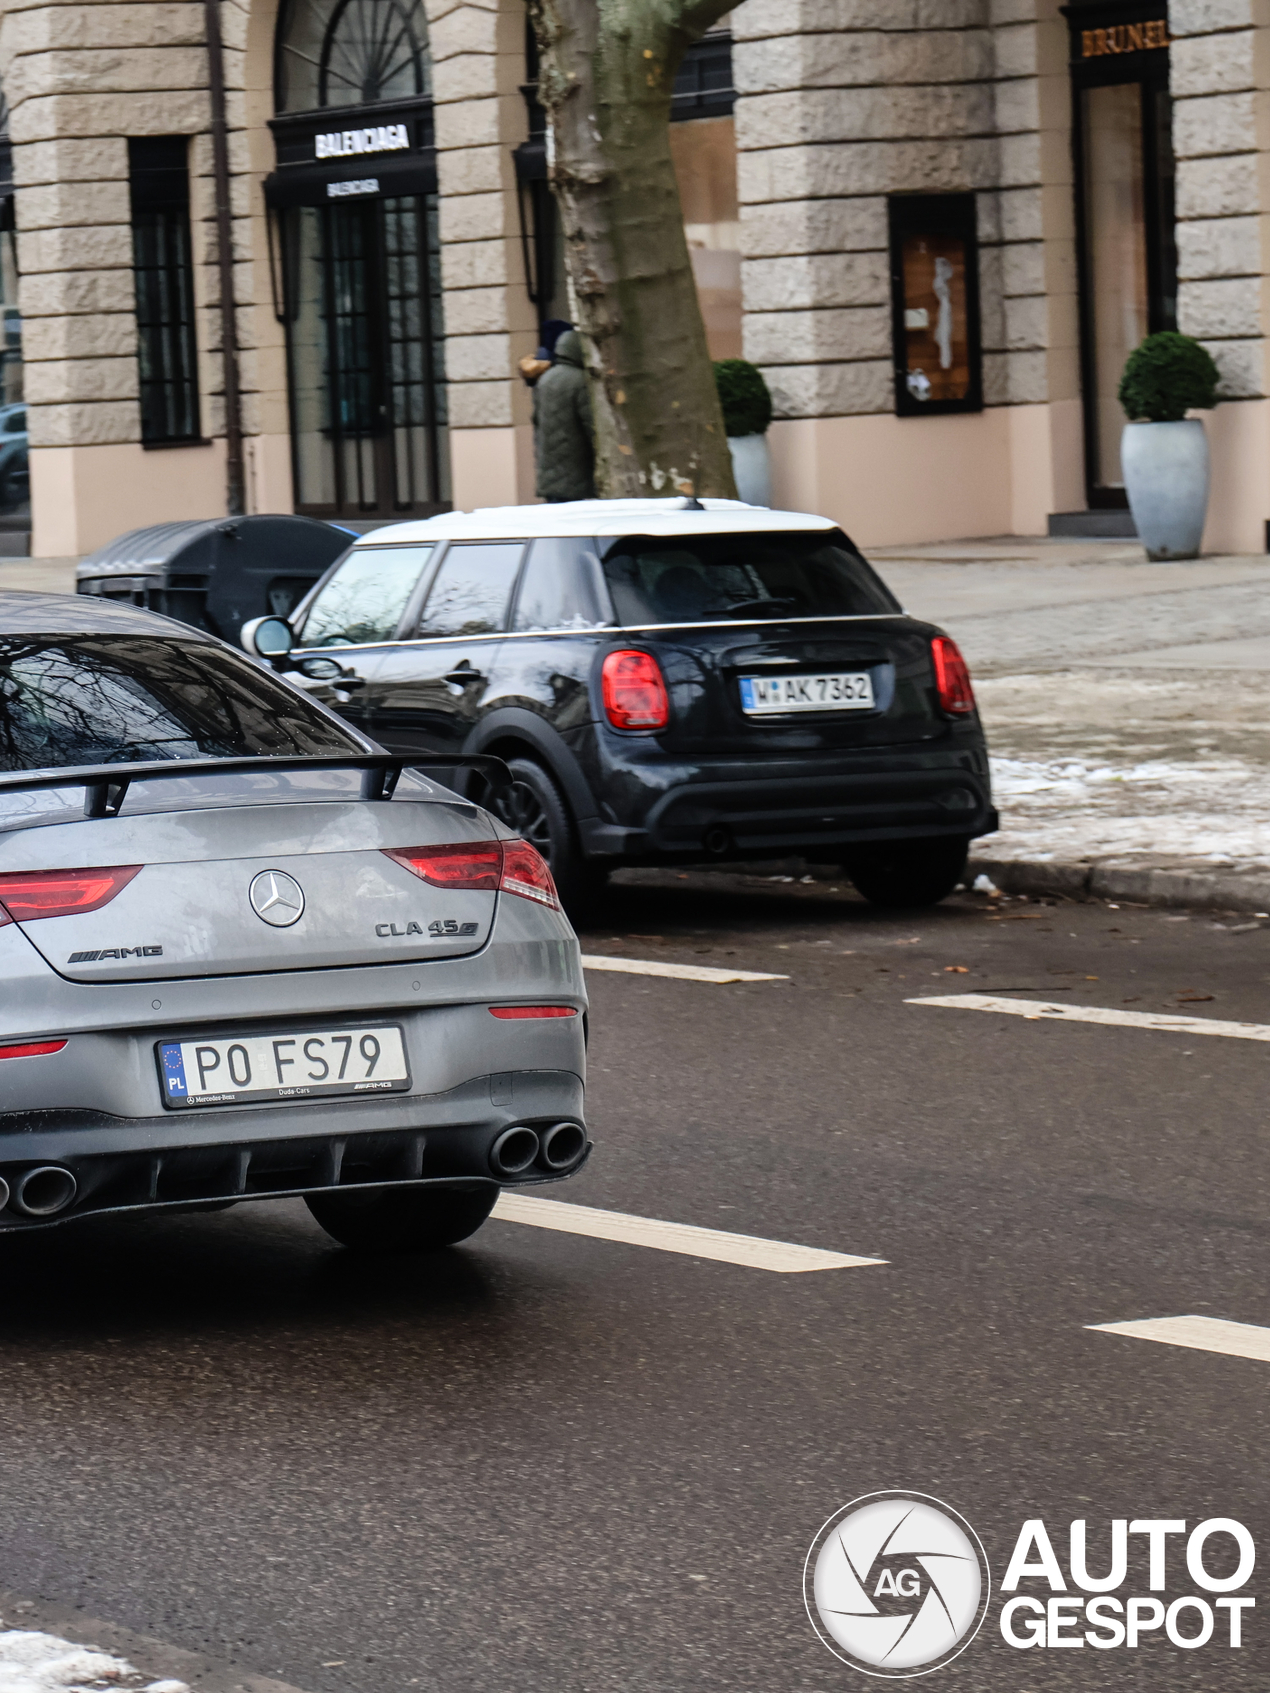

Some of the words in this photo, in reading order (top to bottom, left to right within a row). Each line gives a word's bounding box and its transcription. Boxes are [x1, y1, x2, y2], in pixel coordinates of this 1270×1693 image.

[314, 124, 410, 159] BALENCIAGA
[784, 680, 813, 702] AK
[816, 677, 868, 701] 7362
[375, 921, 423, 937] CLA
[98, 945, 163, 961] AMG
[272, 1034, 381, 1084] FS79
[169, 1077, 184, 1090] PL
[195, 1093, 236, 1104] Mercedes-Benz
[278, 1087, 310, 1096] Duda-Cars
[362, 1081, 392, 1089] AMG
